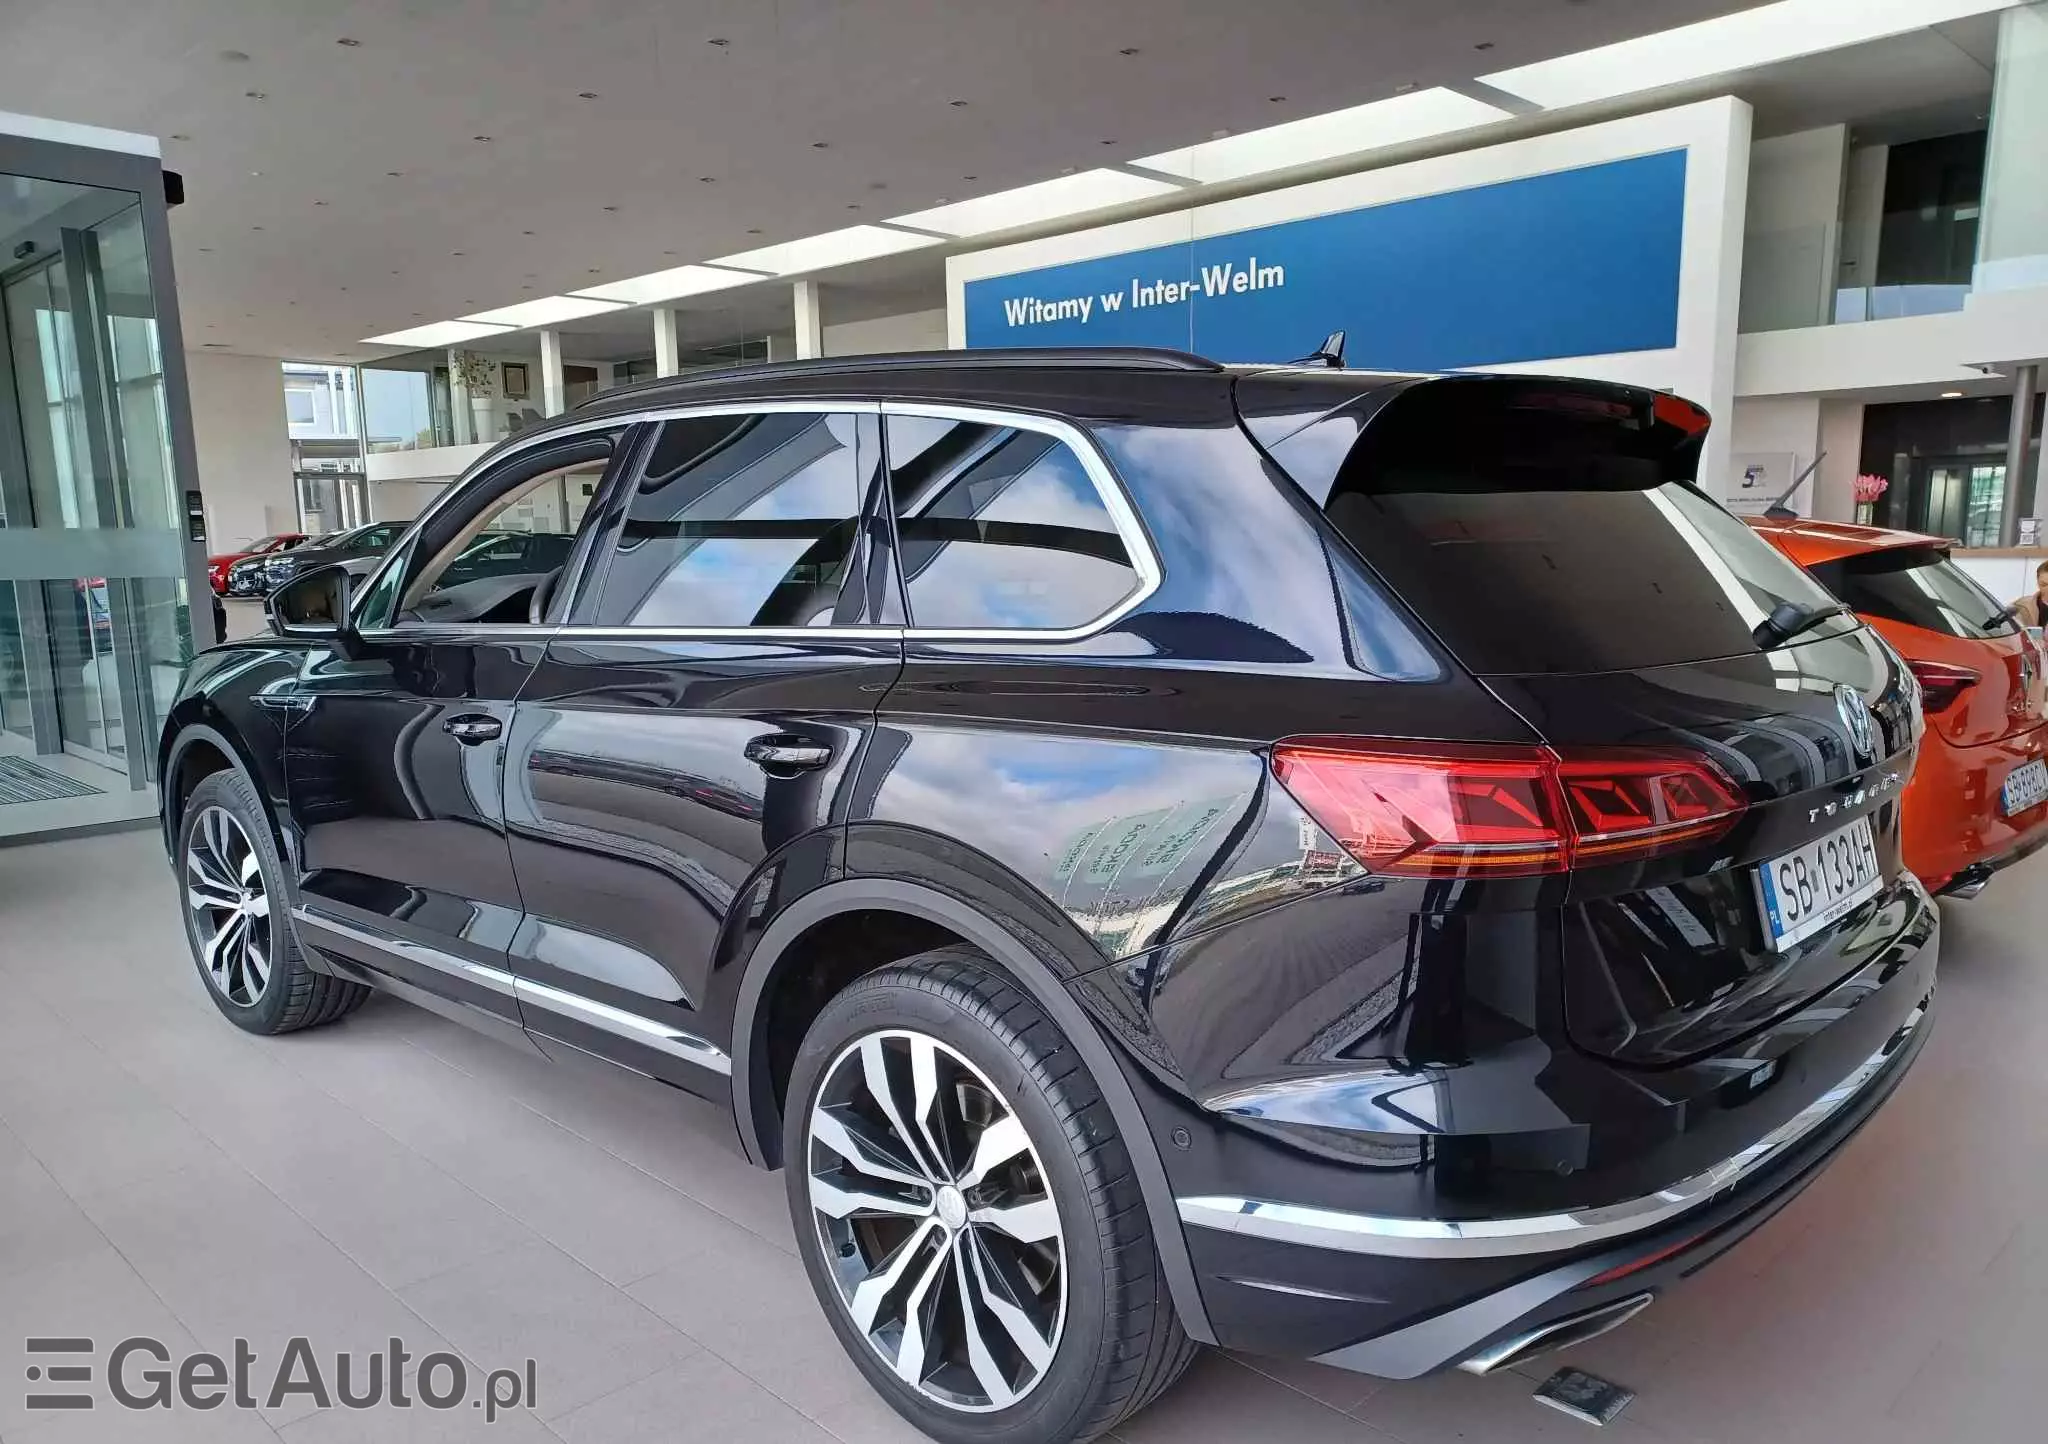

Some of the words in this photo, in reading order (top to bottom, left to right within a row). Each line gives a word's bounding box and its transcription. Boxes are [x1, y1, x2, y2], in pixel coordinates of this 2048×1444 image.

[1004, 296, 1093, 327] Witamy
[1100, 291, 1124, 312] w
[1132, 257, 1285, 309] Inter-Welm
[1769, 910, 1780, 925] PL
